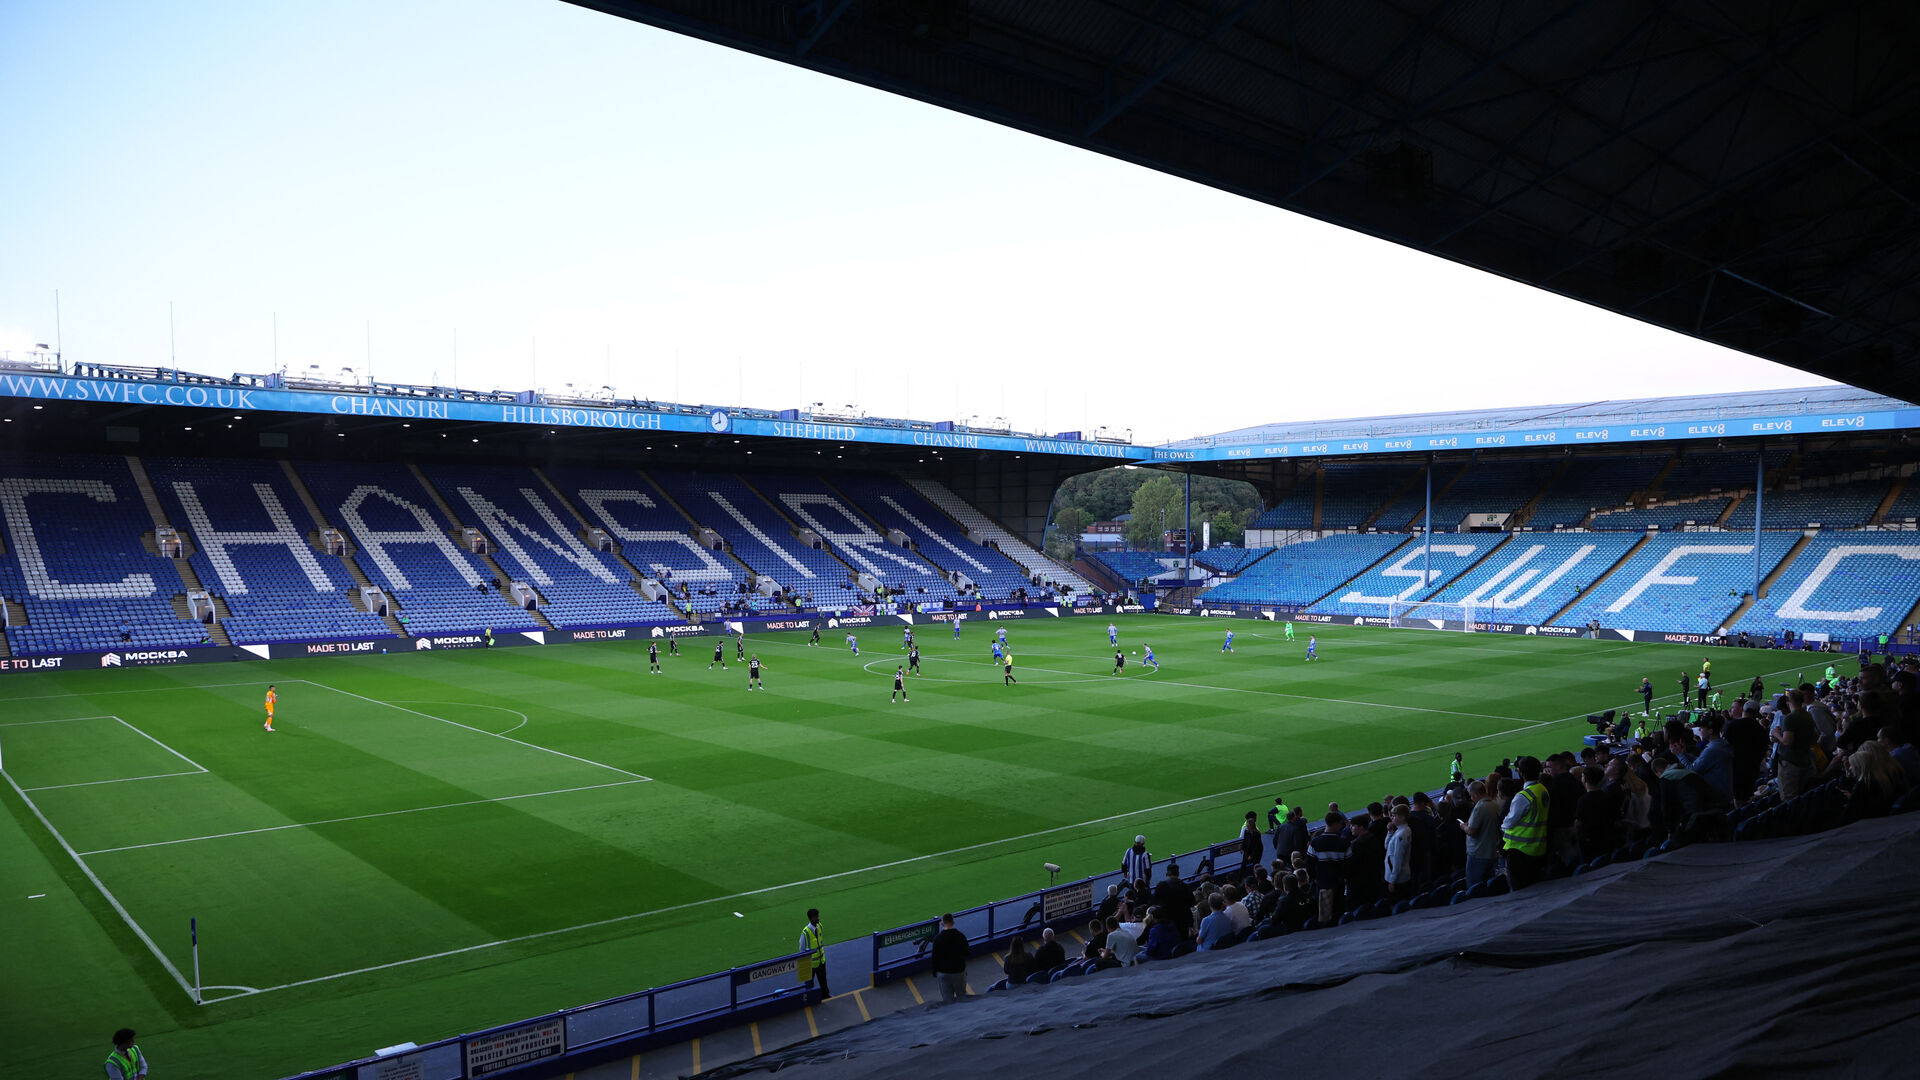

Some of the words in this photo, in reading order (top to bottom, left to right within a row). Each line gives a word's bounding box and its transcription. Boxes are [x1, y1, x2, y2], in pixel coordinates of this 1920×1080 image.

[0, 375, 257, 409] WW.SWFC.CO.UK
[331, 395, 450, 419] CHANSIRI
[502, 405, 662, 430] HILLSBOROUGH
[1821, 416, 1865, 428] ELEV8
[1688, 423, 1725, 434] ELEV8
[1752, 419, 1793, 431] ELEV8
[773, 421, 856, 441] SHEFFIELD
[1524, 431, 1556, 442] ELEV8
[1575, 429, 1609, 440] ELEV8
[1630, 426, 1665, 437] ELEV8
[913, 431, 979, 449] CHANSIRI
[1385, 439, 1412, 449] ELEV8
[1429, 437, 1458, 447] ELEV8
[1475, 434, 1506, 445] ELEV8
[1025, 439, 1125, 458] WWW.SWFC.CO.UK
[1343, 441, 1369, 451] ELEV8
[1154, 451, 1168, 459] THE
[1169, 451, 1194, 459] OWLS
[0, 478, 992, 598] CHANSIRI
[1340, 544, 1920, 621] SWFC
[665, 625, 705, 633] MOCKBA
[766, 622, 785, 630] MADE
[785, 621, 794, 629] TO
[794, 620, 810, 628] LAST
[1539, 626, 1577, 634] MOCKBA
[573, 631, 596, 640] MADE
[597, 631, 607, 639] TO
[607, 629, 626, 638] LAST
[1664, 634, 1687, 642] MADE
[434, 636, 482, 645] MOCKBA
[307, 644, 335, 653] MADE
[336, 643, 350, 652] TO
[351, 642, 375, 651] LAST
[125, 650, 188, 660] MOCKBA
[12, 659, 29, 669] TO
[31, 657, 63, 669] LAST
[752, 965, 785, 980] GANGWAY
[787, 961, 796, 970] 14
